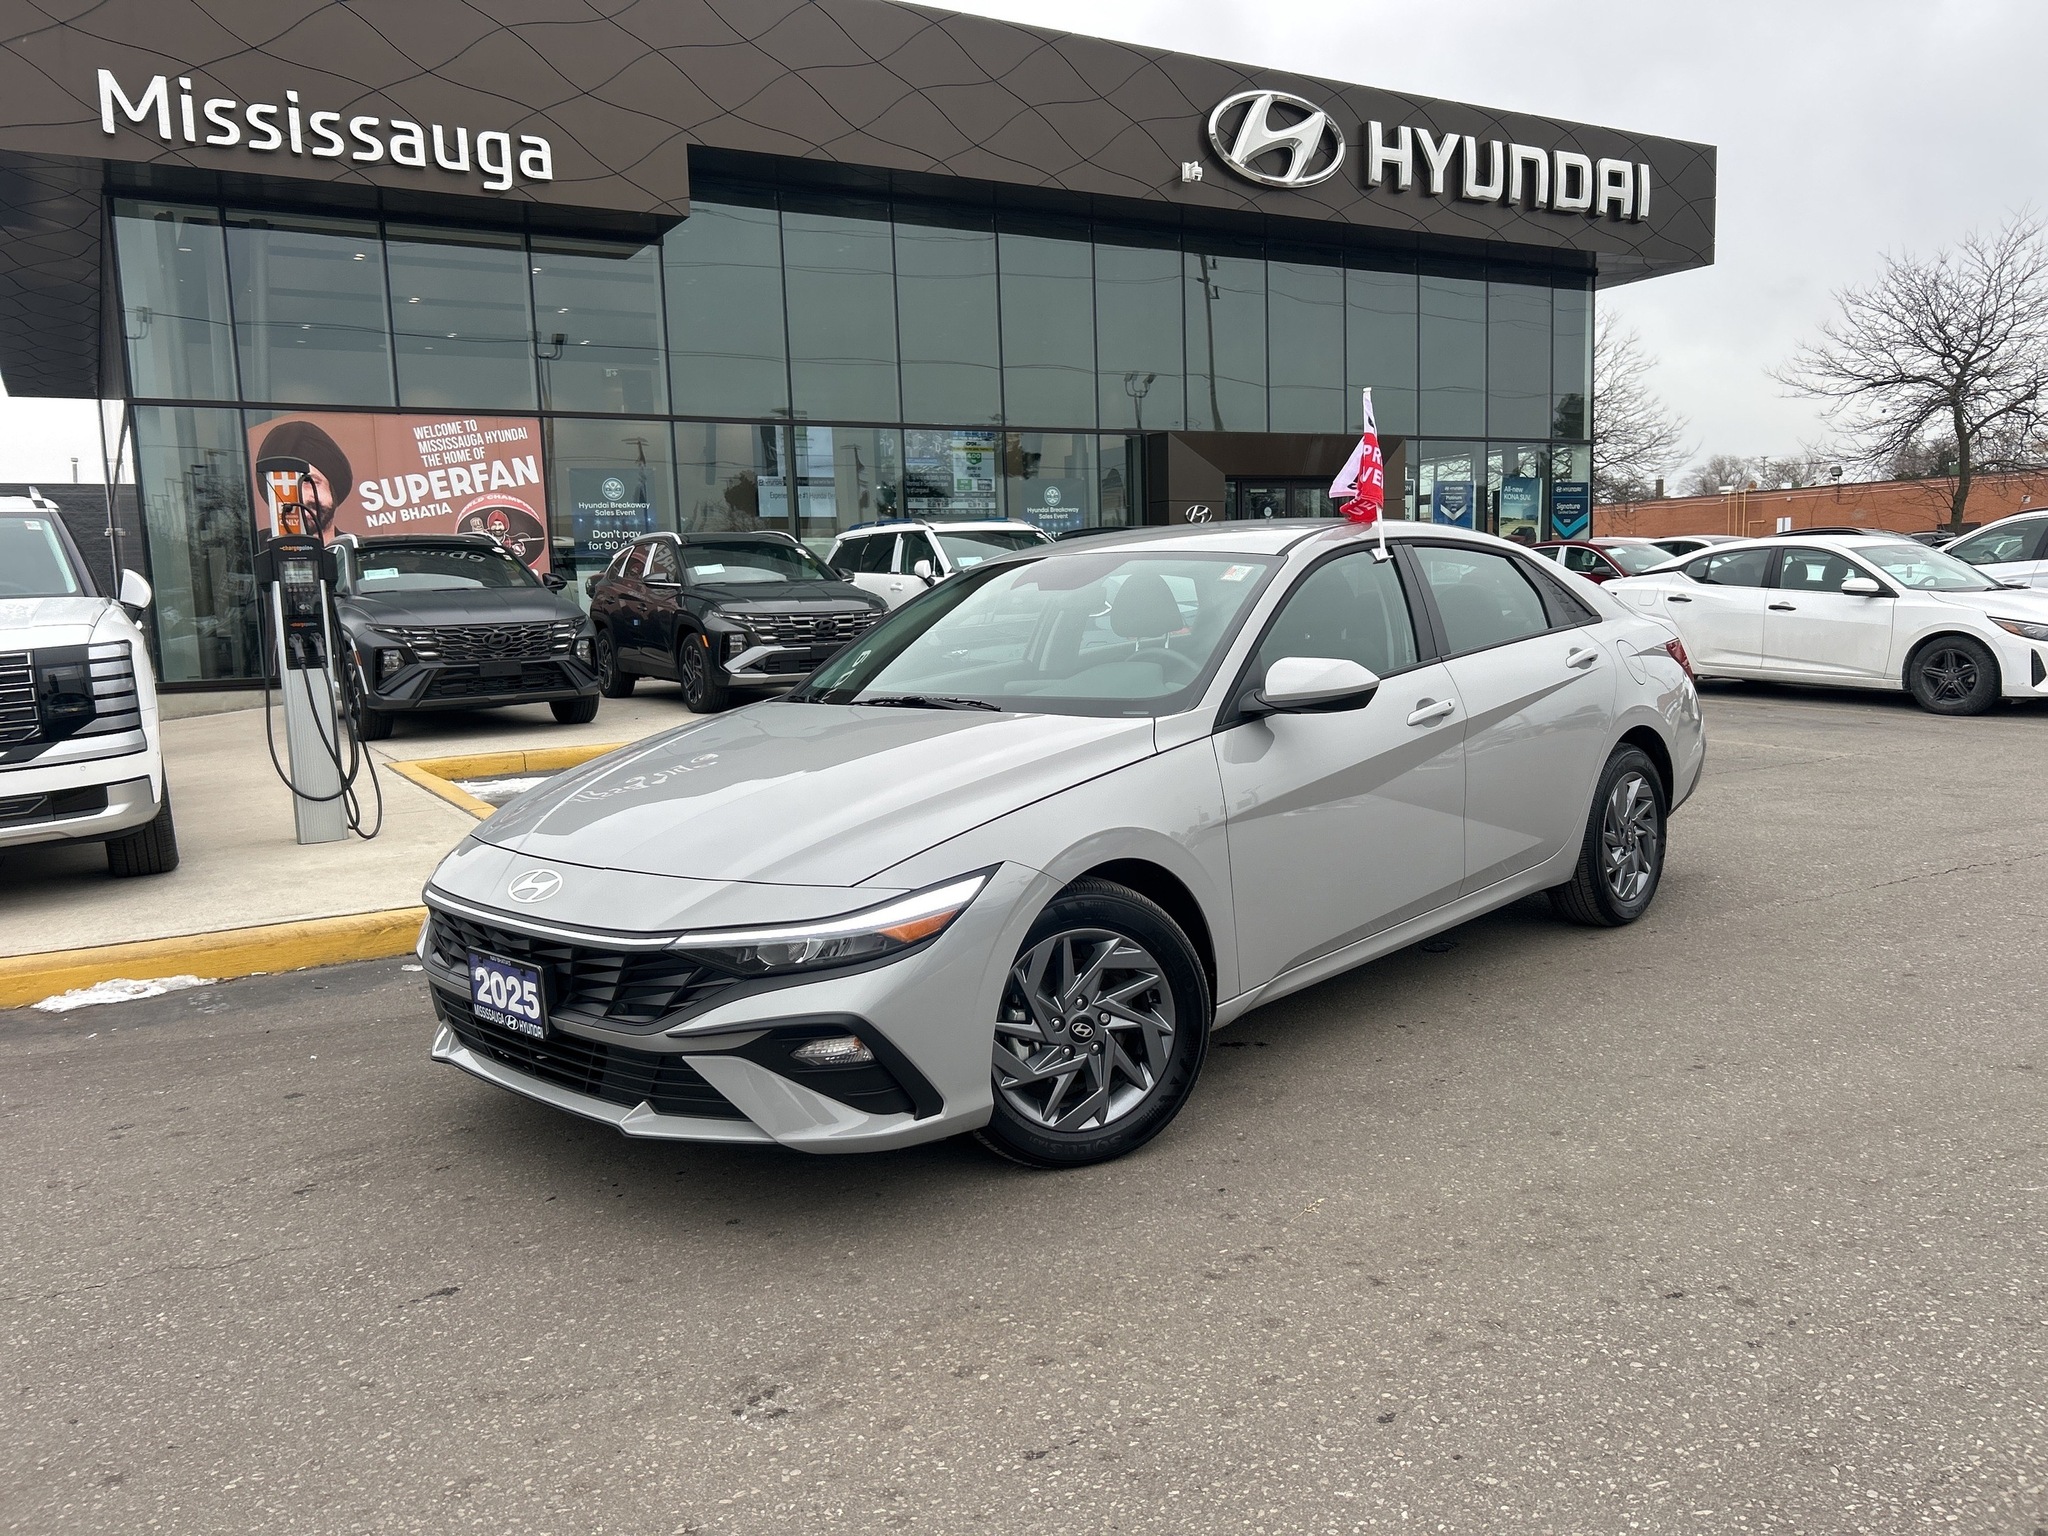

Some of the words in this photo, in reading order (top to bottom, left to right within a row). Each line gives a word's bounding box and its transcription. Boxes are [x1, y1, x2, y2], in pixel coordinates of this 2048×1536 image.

[96, 67, 554, 192] Mississauga
[1367, 120, 1651, 222] HYUNDAI
[413, 421, 463, 440] WELCOME
[464, 419, 478, 432] TO
[418, 433, 484, 454] MISSISSAUGA
[485, 427, 528, 444] HYUNDAI
[421, 454, 441, 468] THE
[444, 449, 472, 464] HOME
[473, 447, 486, 460] OF
[358, 455, 540, 512] SUPERFAN
[366, 510, 397, 528] NAV
[400, 501, 452, 522] BHATIA
[578, 502, 610, 510] Hyundai
[610, 501, 651, 510] Breakaway
[588, 541, 603, 550] for
[604, 541, 619, 550] 90
[592, 529, 620, 539] Don't
[622, 530, 641, 540] pay
[475, 966, 540, 1019] 2025
[474, 1003, 505, 1025] MISSISSAUGA
[519, 1019, 544, 1039] HYUNDAI
